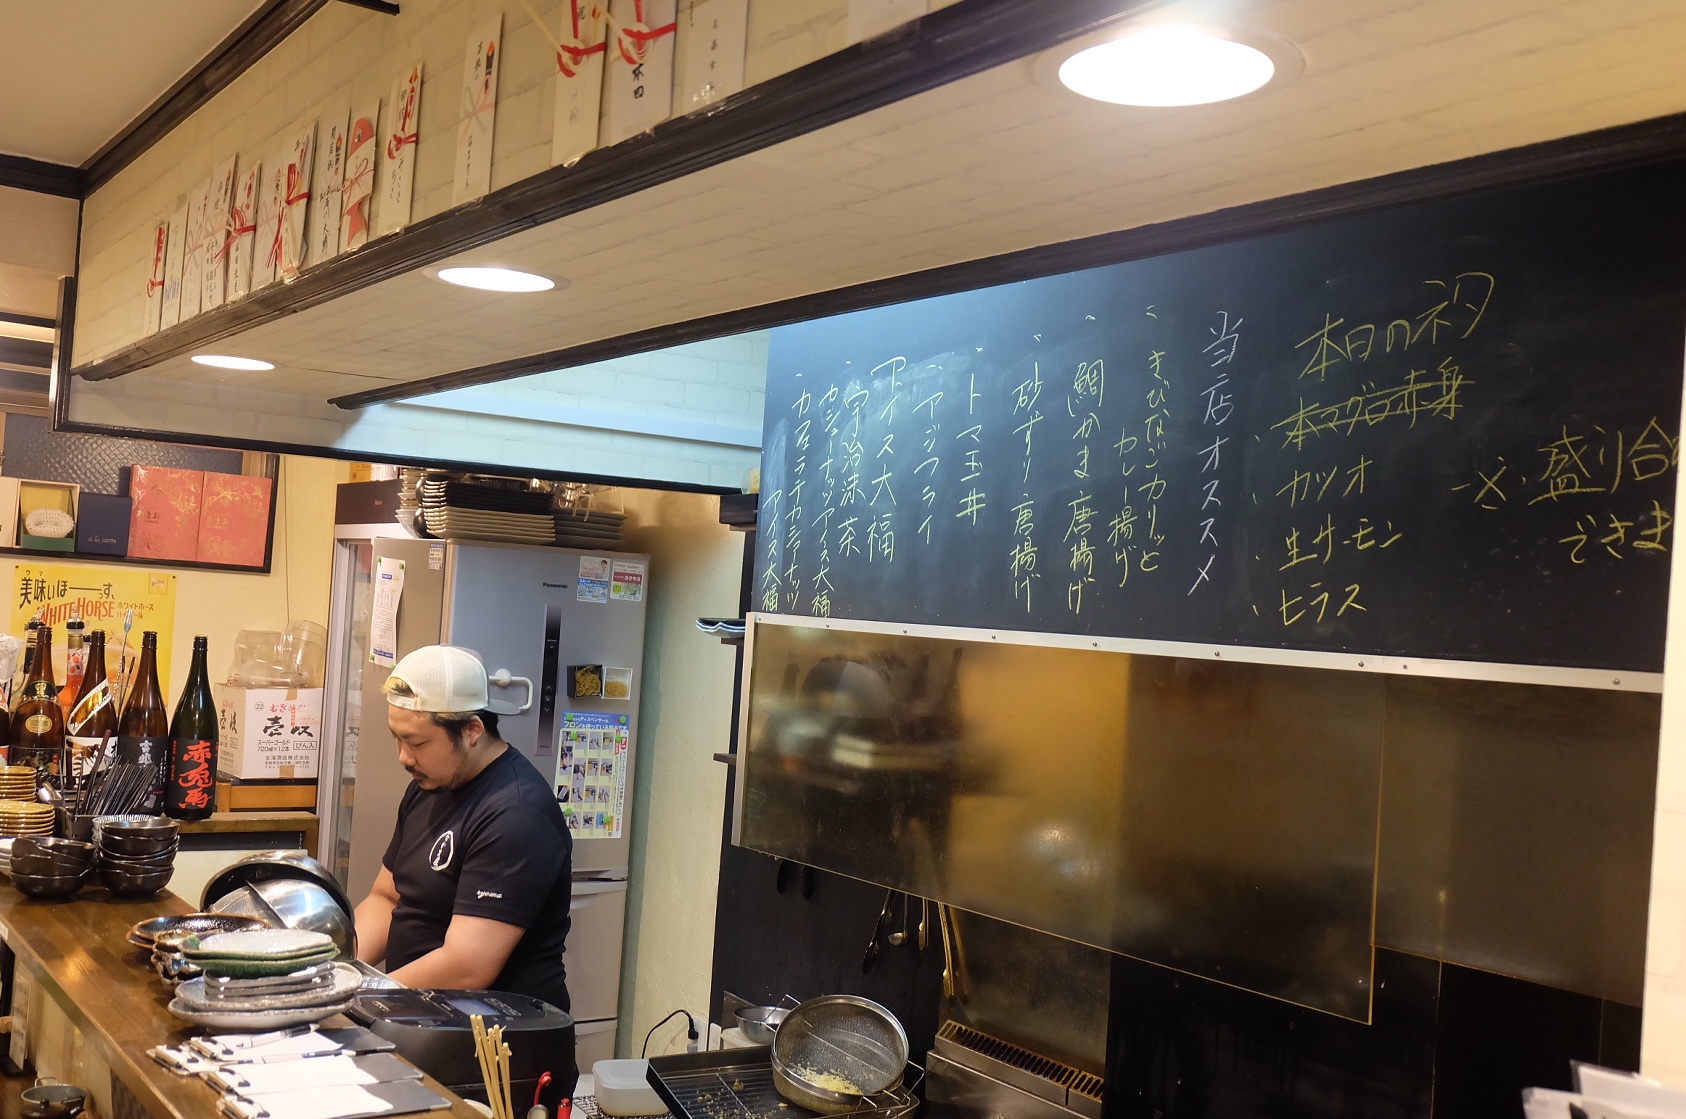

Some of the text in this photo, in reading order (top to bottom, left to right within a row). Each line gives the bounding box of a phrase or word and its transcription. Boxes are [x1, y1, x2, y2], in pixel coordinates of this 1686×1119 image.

[866, 355, 907, 563] アイス大福
[912, 390, 945, 545] アジフライ
[1187, 310, 1244, 597] 当店オススメ
[1275, 454, 1373, 508] カツオ
[1279, 512, 1403, 571] 生サーモン
[77, 597, 115, 621] HORSE
[1279, 582, 1367, 626] ヒラス
